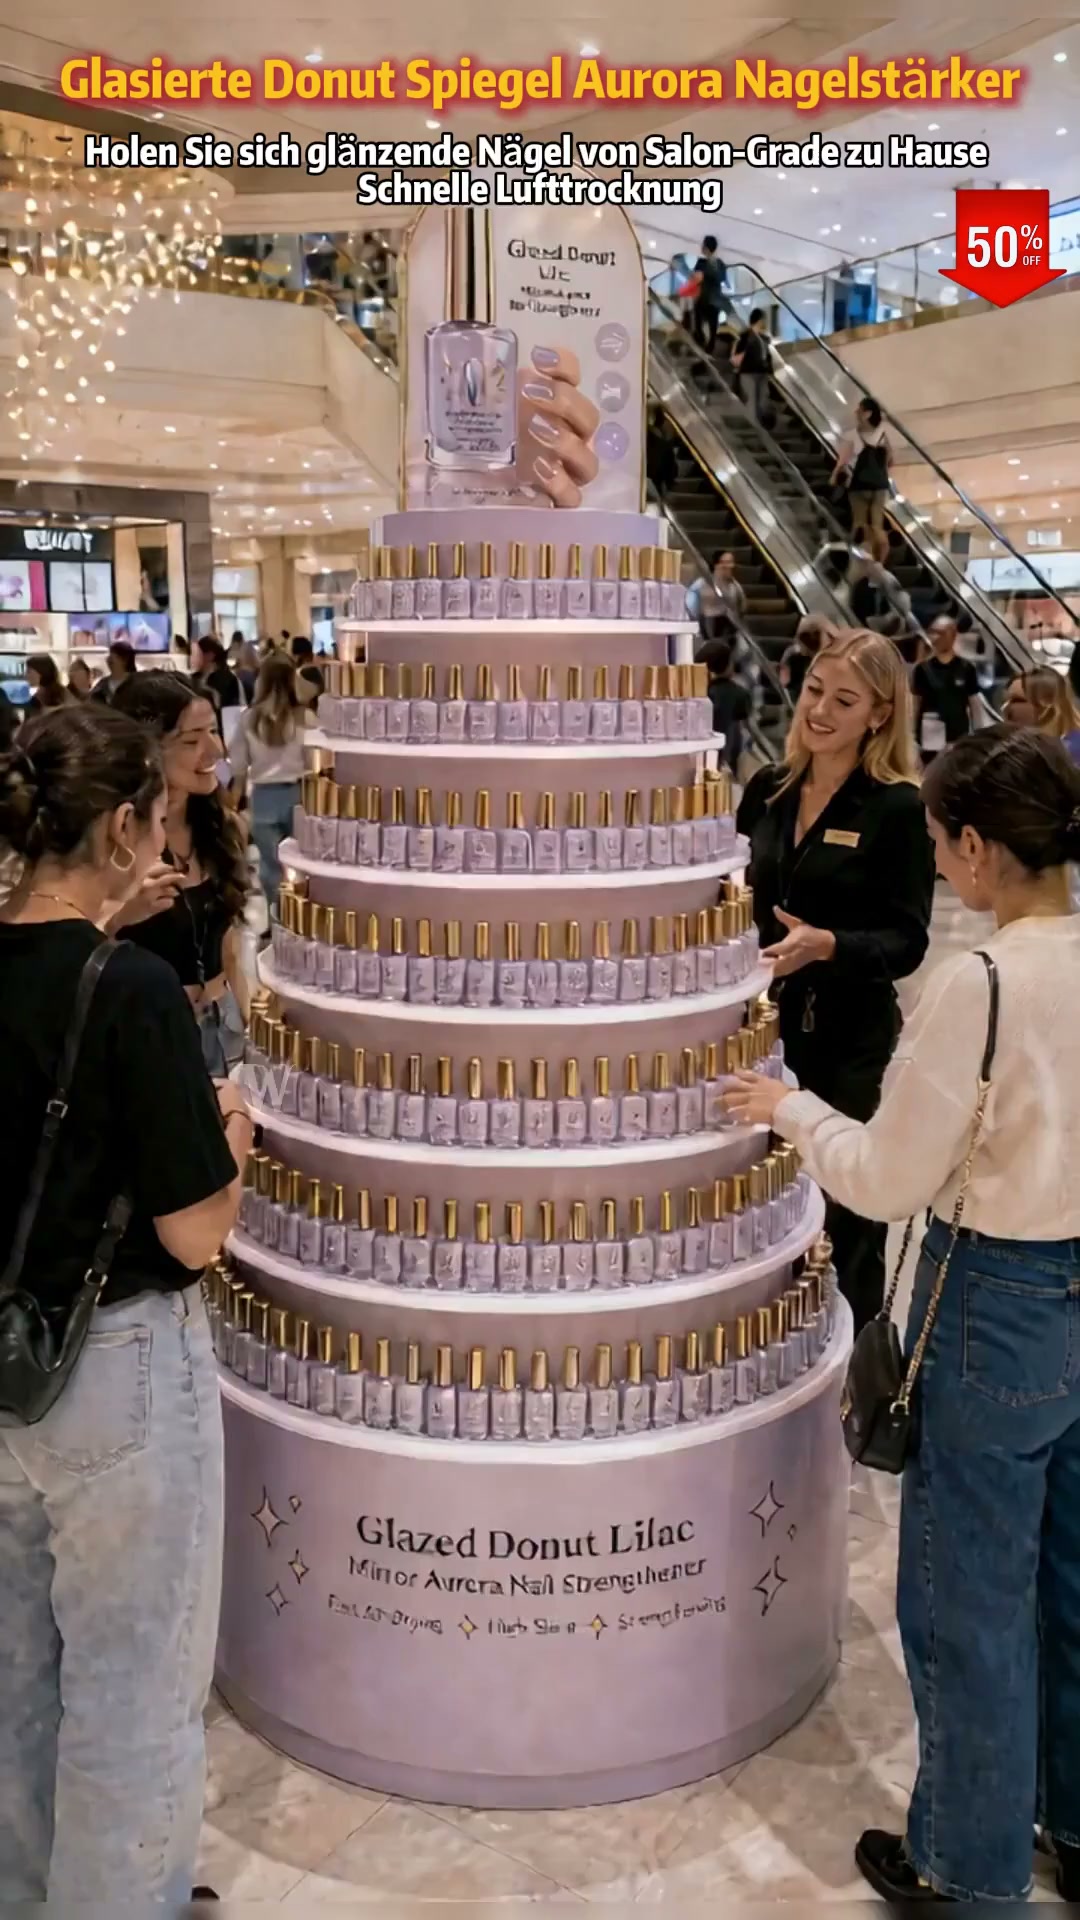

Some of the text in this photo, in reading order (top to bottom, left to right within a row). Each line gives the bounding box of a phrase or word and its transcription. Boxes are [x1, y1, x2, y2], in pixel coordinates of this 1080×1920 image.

[356, 1514, 696, 1561] Glazed Donut Lilac
